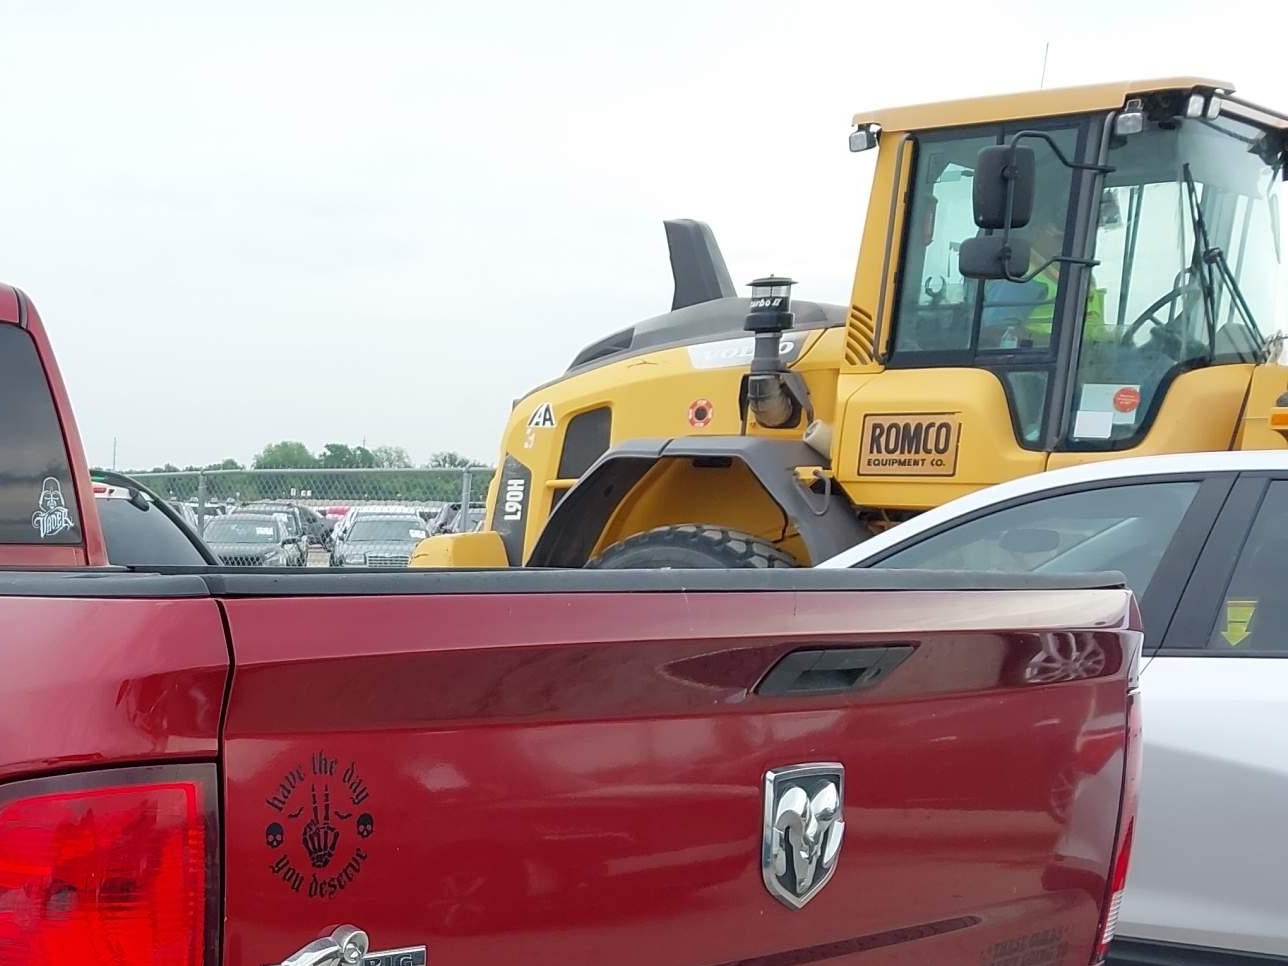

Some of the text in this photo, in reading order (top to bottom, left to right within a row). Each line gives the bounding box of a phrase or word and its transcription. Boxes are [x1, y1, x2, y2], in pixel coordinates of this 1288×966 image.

[869, 422, 952, 455] ROMCO
[867, 458, 946, 467] EQUIPMENT CO.
[504, 479, 525, 521] L90H
[265, 750, 369, 812] have the day
[269, 848, 368, 899] you deserve
